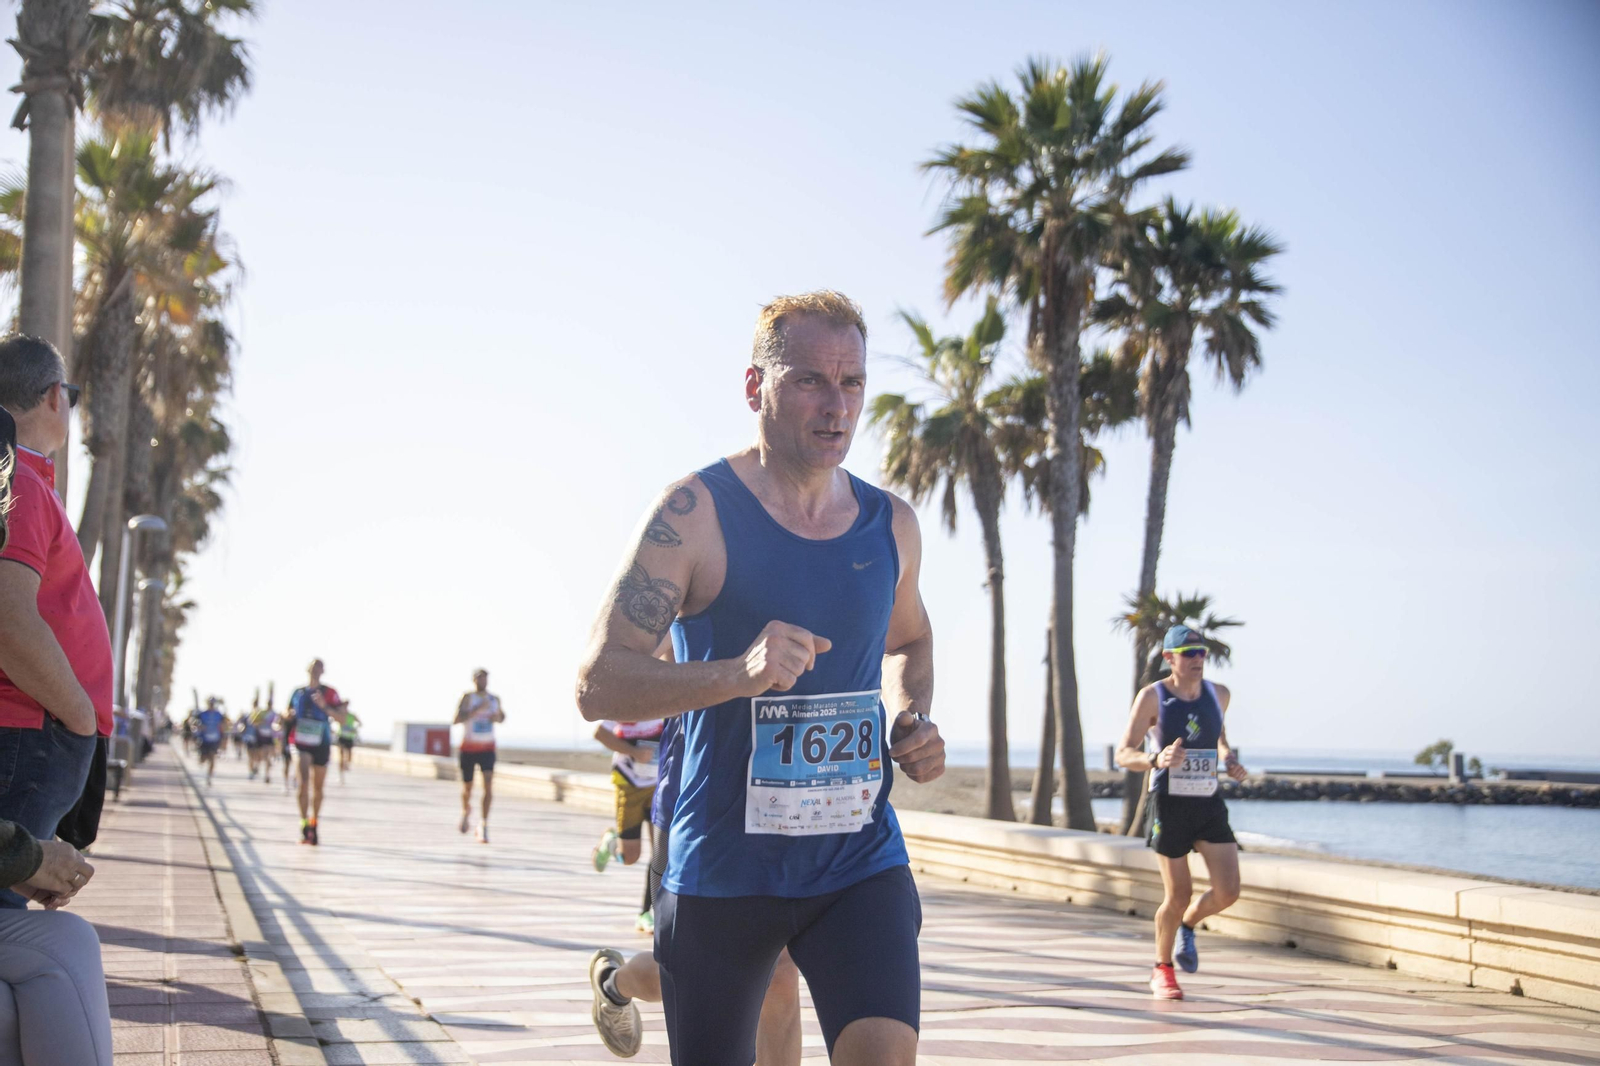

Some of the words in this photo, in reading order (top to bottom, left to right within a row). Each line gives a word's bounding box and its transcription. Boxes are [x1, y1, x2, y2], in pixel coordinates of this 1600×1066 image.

[819, 707, 837, 717] 2025
[773, 719, 873, 765] 1628
[817, 764, 839, 773] DAVID
